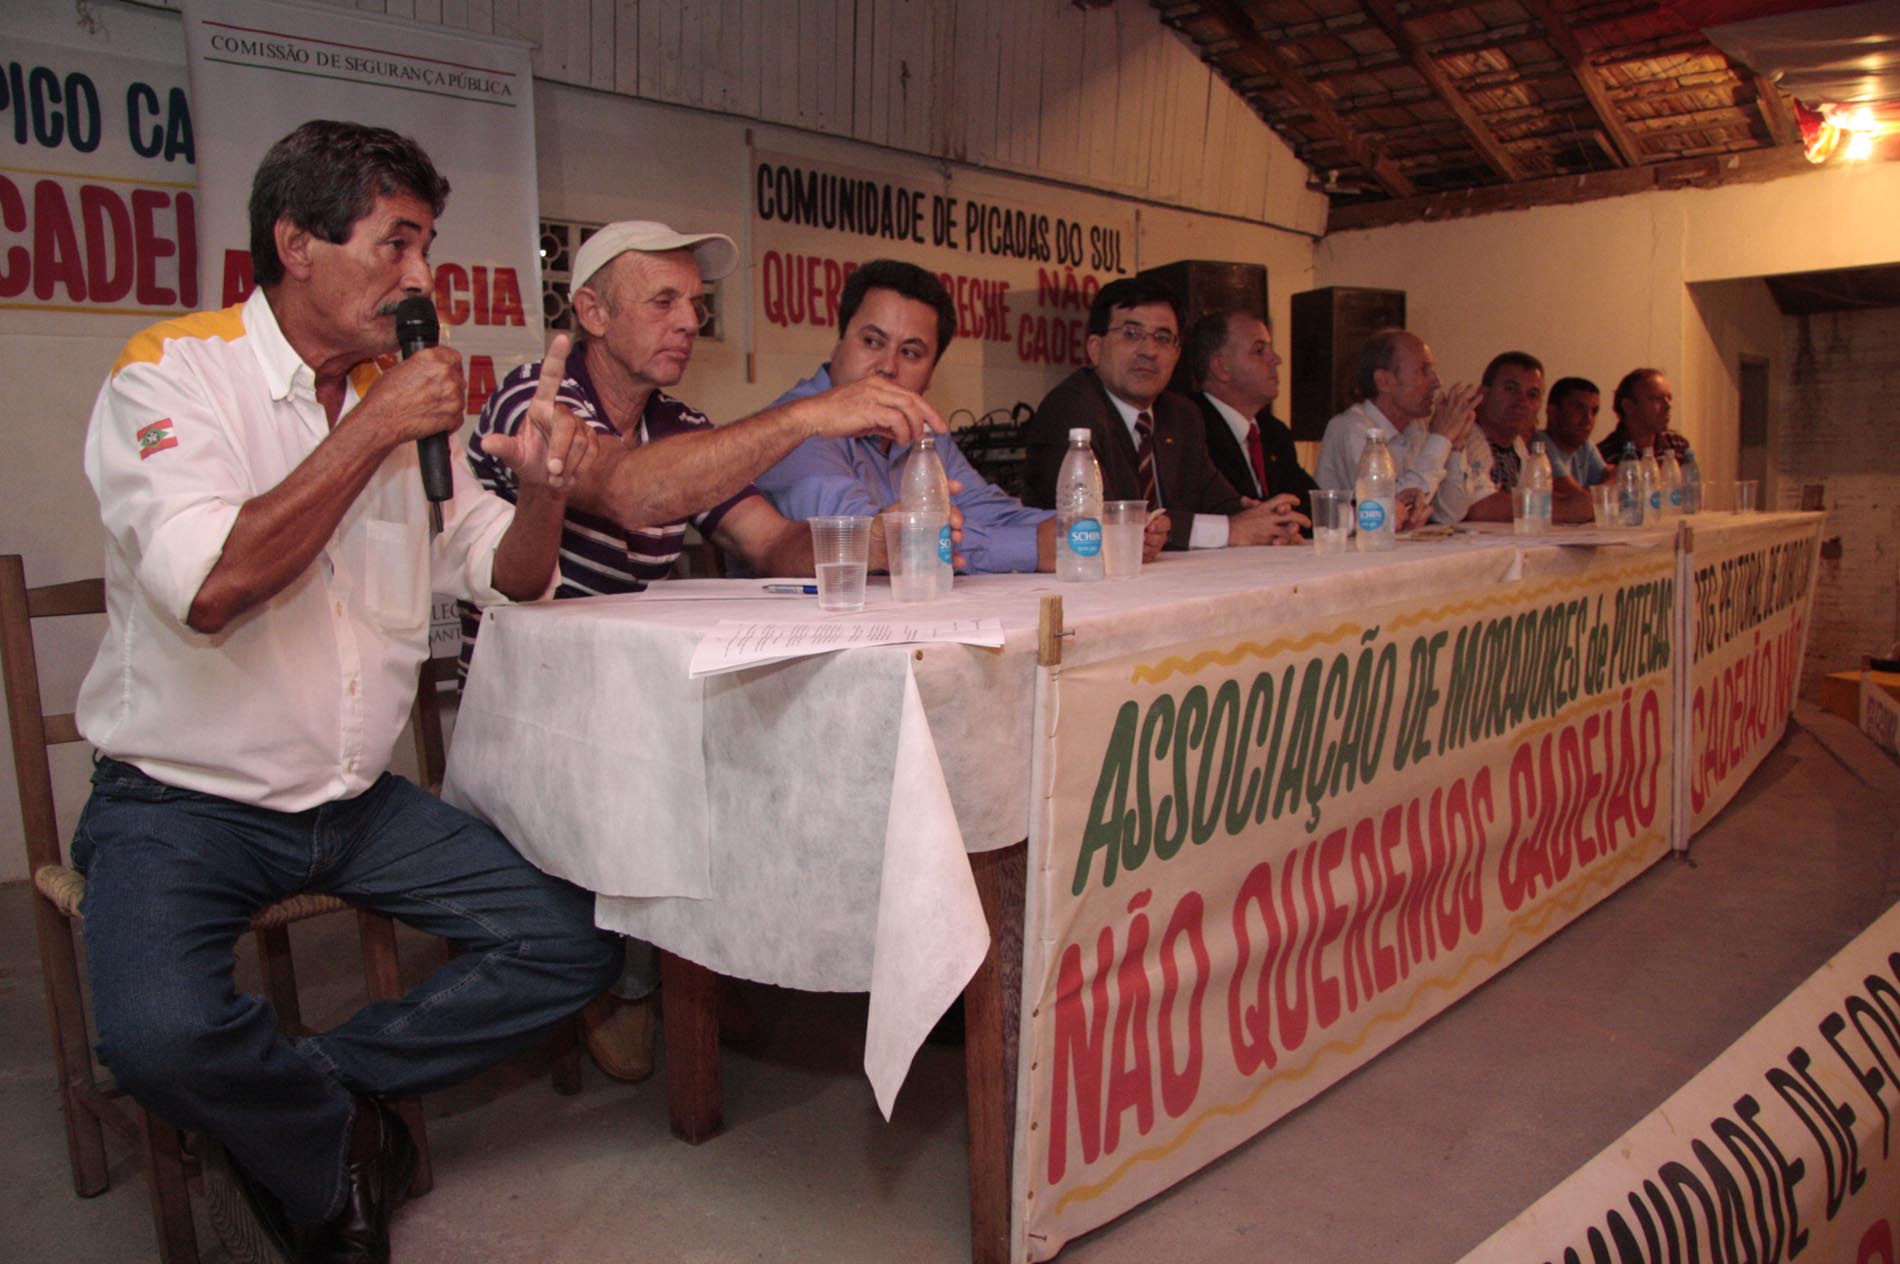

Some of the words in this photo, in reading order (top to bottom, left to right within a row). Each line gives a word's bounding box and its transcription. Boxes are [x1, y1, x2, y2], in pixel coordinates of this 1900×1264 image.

[211, 34, 309, 64] COMISSÃO
[316, 51, 341, 70] DE
[345, 56, 445, 86] SEGURANÇA
[448, 71, 512, 97] PÚBLICA
[757, 163, 925, 244] COMUNIDADE
[932, 195, 958, 249] DE
[966, 201, 1050, 263] PICADAS
[1056, 218, 1083, 268] DO
[1090, 225, 1126, 274] SUL
[1017, 313, 1092, 366] CADE
[1072, 625, 1397, 896] ASSOCIAÇÃO
[1396, 630, 1448, 771] DE
[1437, 596, 1588, 757] MORADORES
[1691, 627, 1773, 815] CADEIÃO
[1048, 888, 1210, 1185] NÃO
[1227, 765, 1495, 1077] QUEREMOS
[1499, 686, 1662, 912] CADEIÃO
[1764, 1046, 1867, 1221] DE
